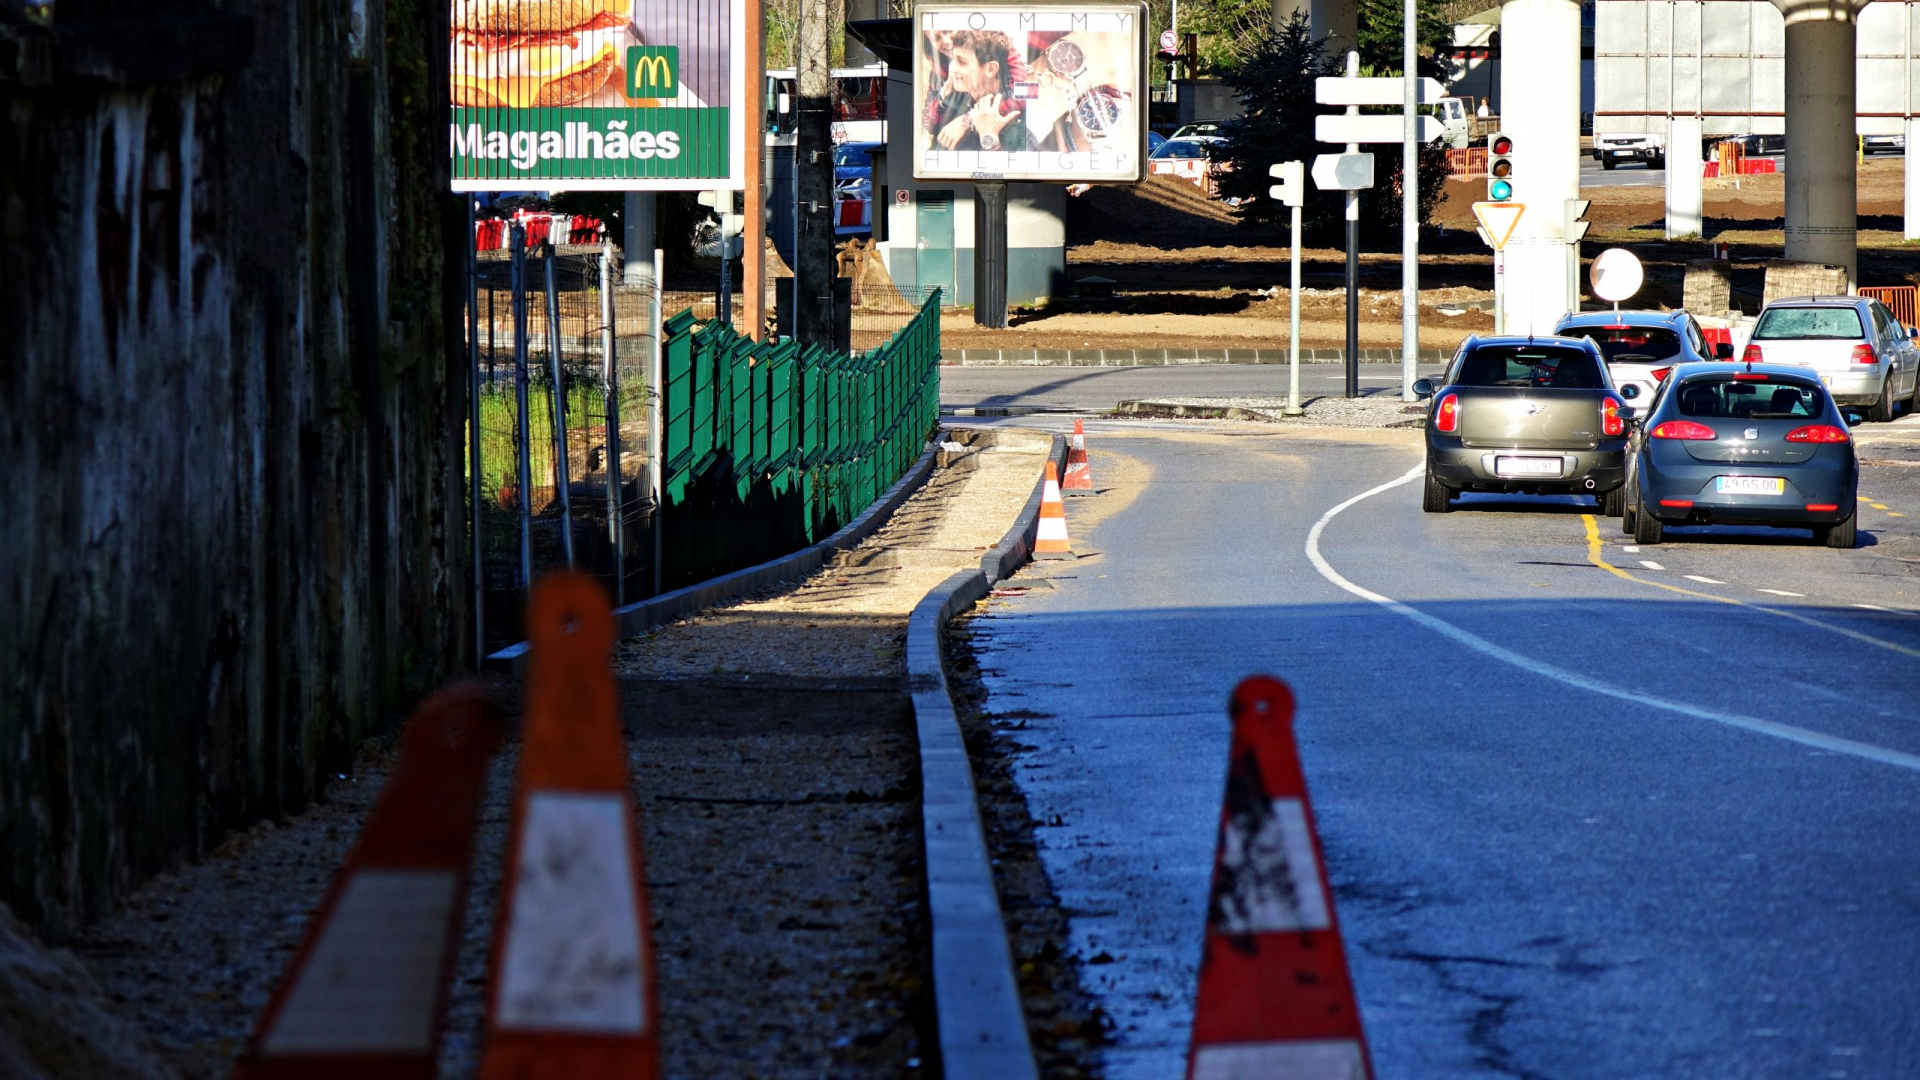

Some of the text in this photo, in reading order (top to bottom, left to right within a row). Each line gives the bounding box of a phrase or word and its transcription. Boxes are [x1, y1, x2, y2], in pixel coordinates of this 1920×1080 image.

[925, 12, 1130, 31] TOMMY
[450, 119, 680, 170] Magalhães
[924, 150, 1128, 170] HILFIGER
[970, 171, 1004, 179] JCDecaux
[1724, 479, 1777, 491] 49 GS 00
